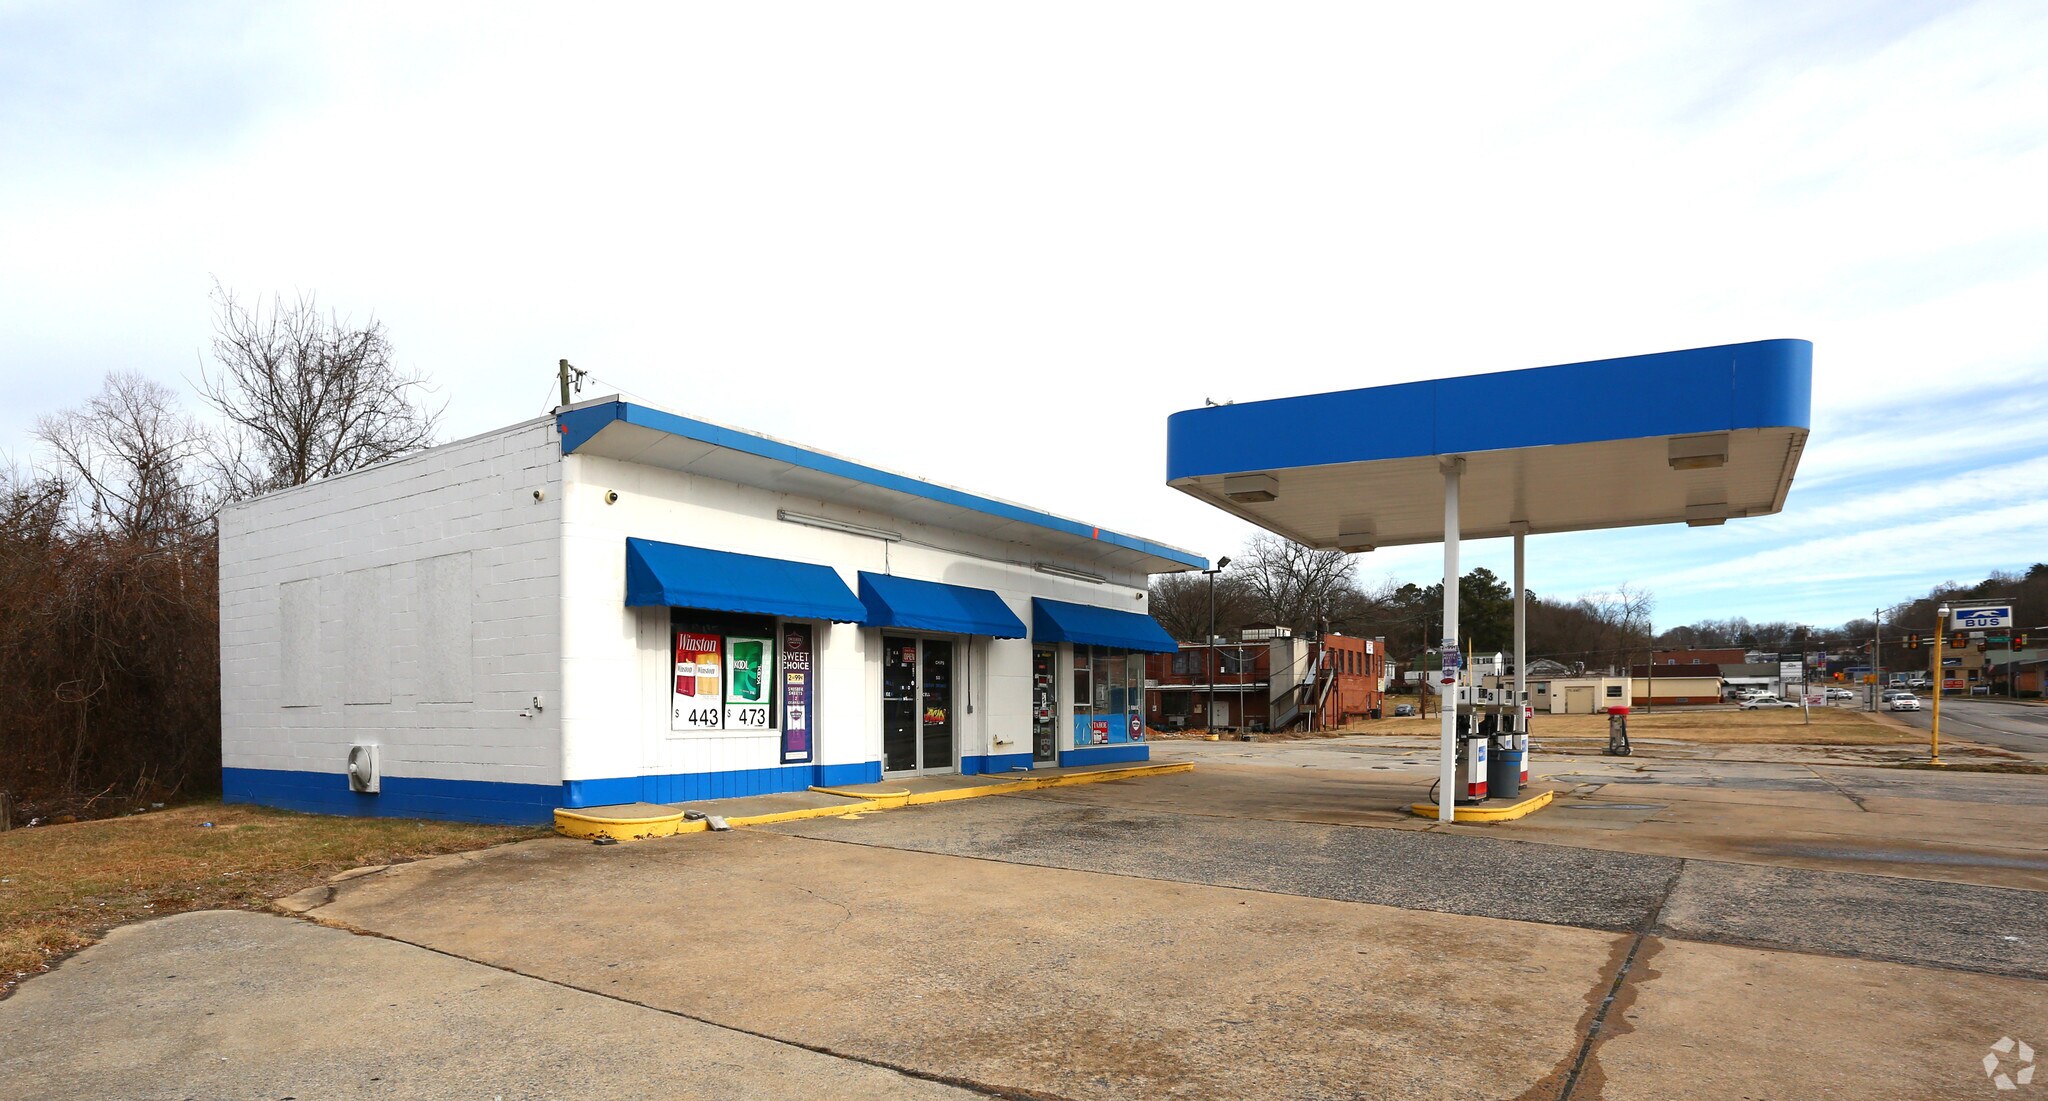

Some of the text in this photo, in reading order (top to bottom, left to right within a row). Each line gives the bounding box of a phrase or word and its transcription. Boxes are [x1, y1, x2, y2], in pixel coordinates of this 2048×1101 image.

[1965, 618, 2000, 627] BUS
[679, 633, 717, 652] Winston
[783, 652, 809, 662] SWEET
[903, 653, 915, 661] OPEN
[733, 660, 750, 670] KOOL
[783, 661, 810, 670] CHOICE
[1460, 690, 1465, 700] 1
[1488, 692, 1494, 701] 3
[675, 708, 680, 718] $
[727, 708, 731, 718] $
